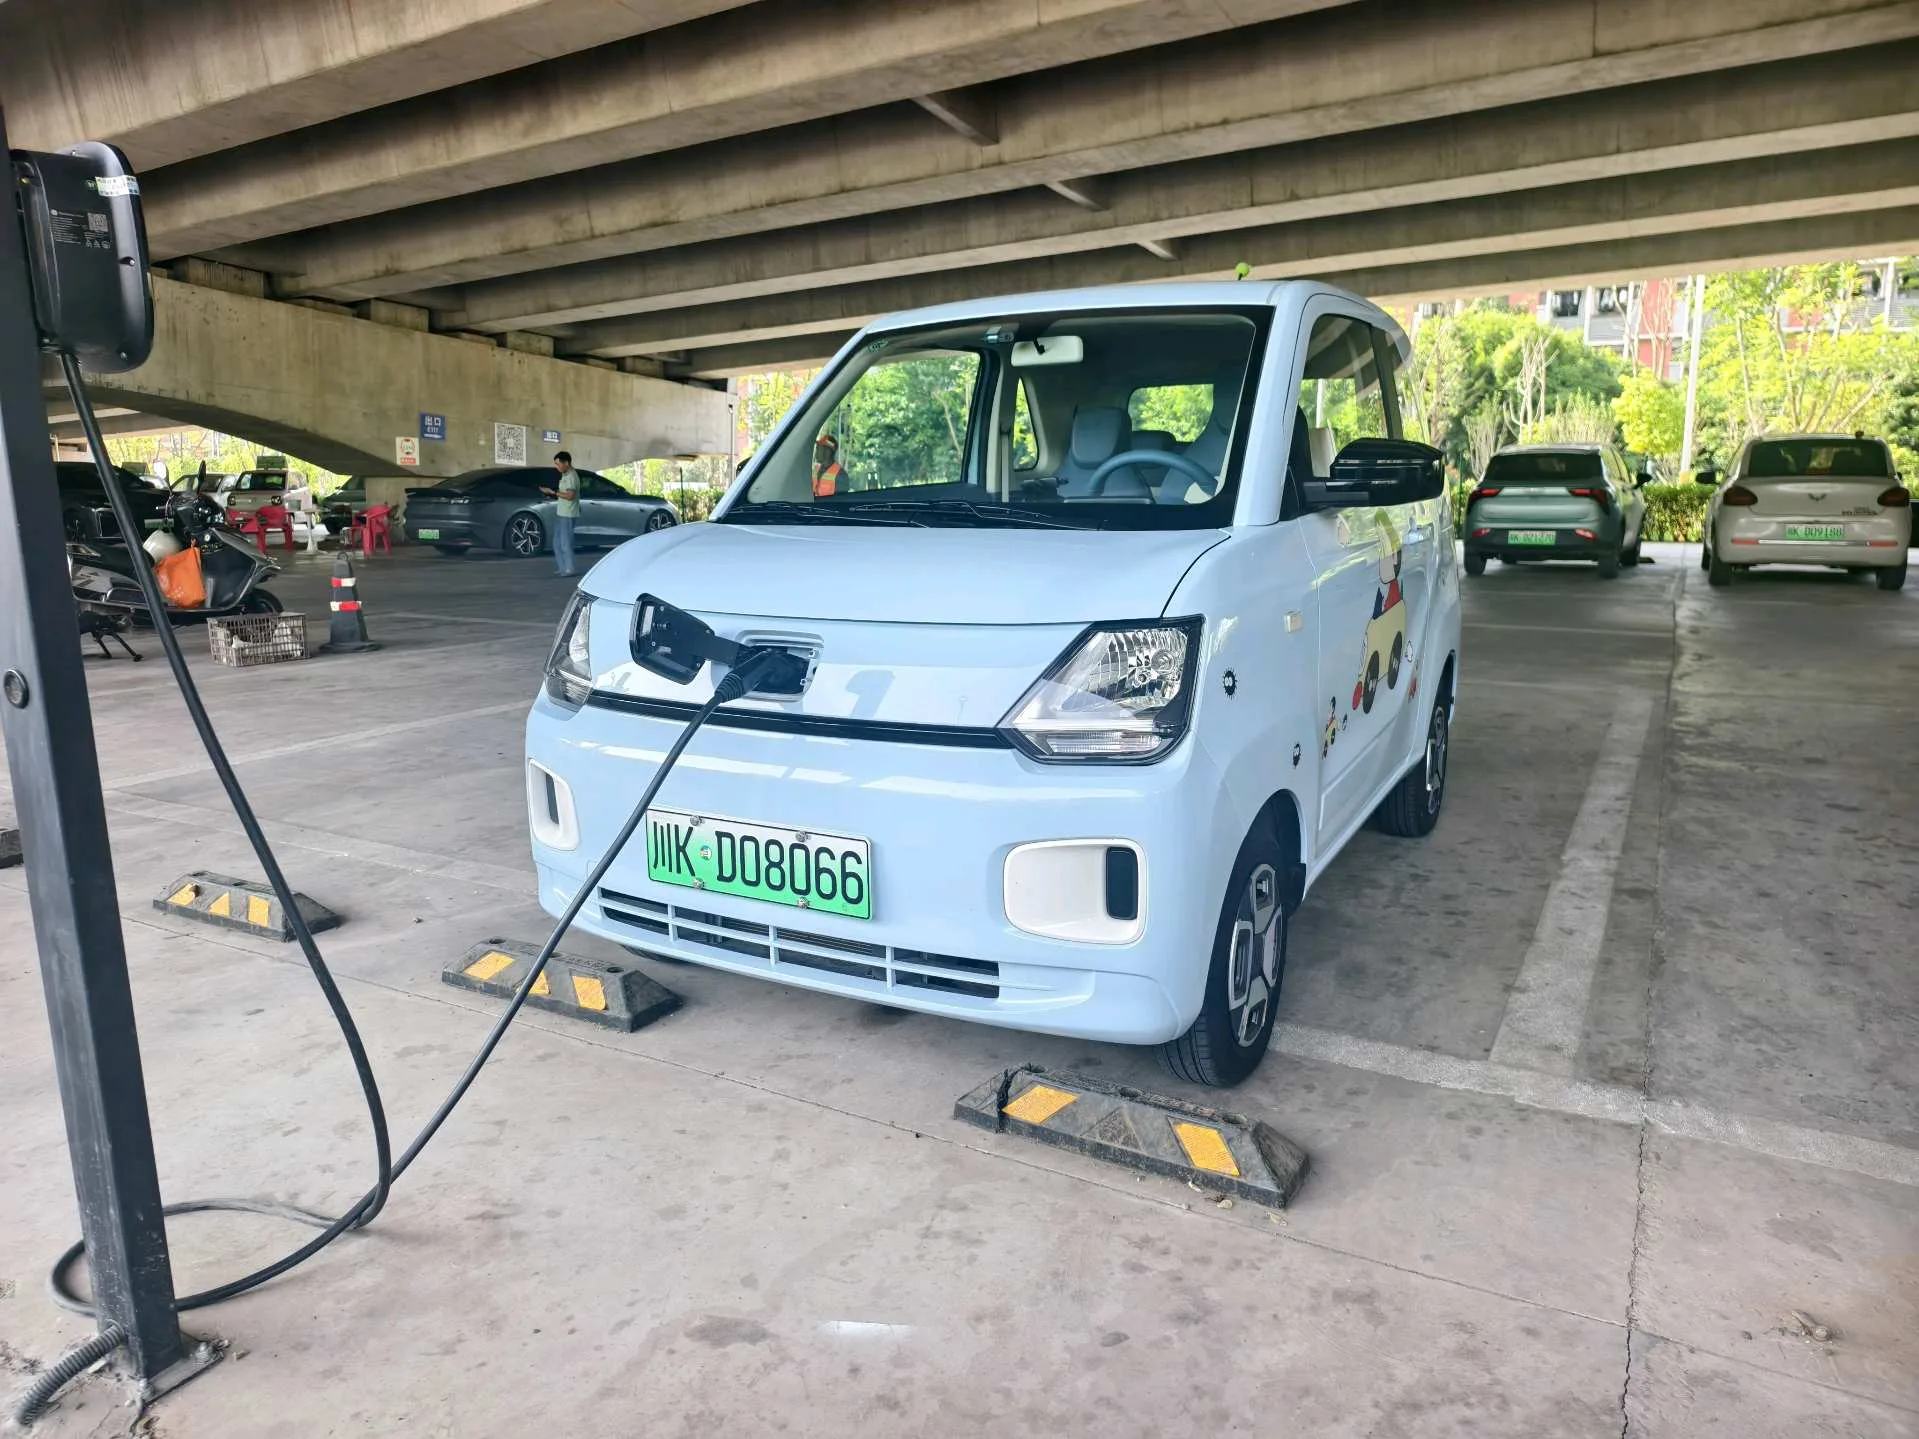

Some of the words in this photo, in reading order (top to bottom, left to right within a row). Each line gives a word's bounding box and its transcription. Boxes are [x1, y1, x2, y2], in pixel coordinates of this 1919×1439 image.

[425, 415, 441, 426] 出口
[653, 821, 697, 877] 川K
[715, 830, 864, 905] D08066
